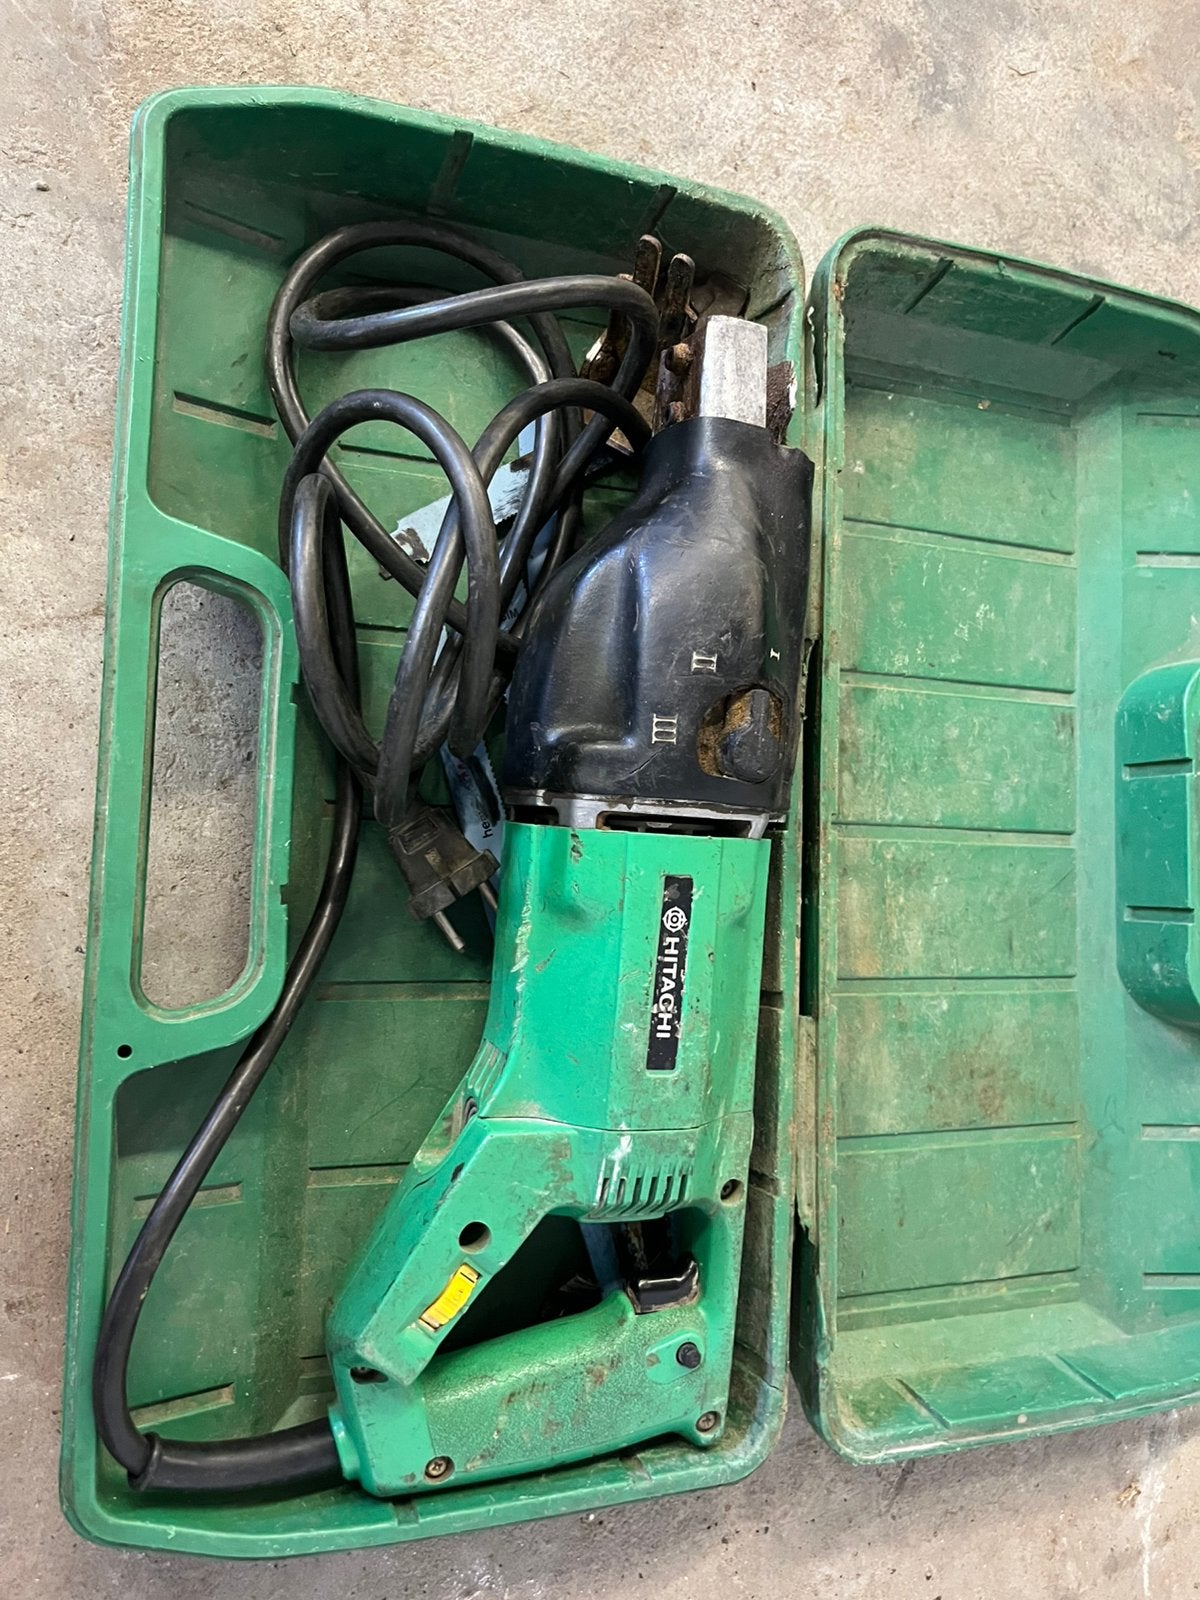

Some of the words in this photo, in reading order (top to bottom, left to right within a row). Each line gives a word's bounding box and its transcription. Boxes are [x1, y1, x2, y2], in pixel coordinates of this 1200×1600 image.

[691, 651, 717, 673] II
[651, 713, 678, 745] III
[656, 936, 680, 1039] HITACHI
